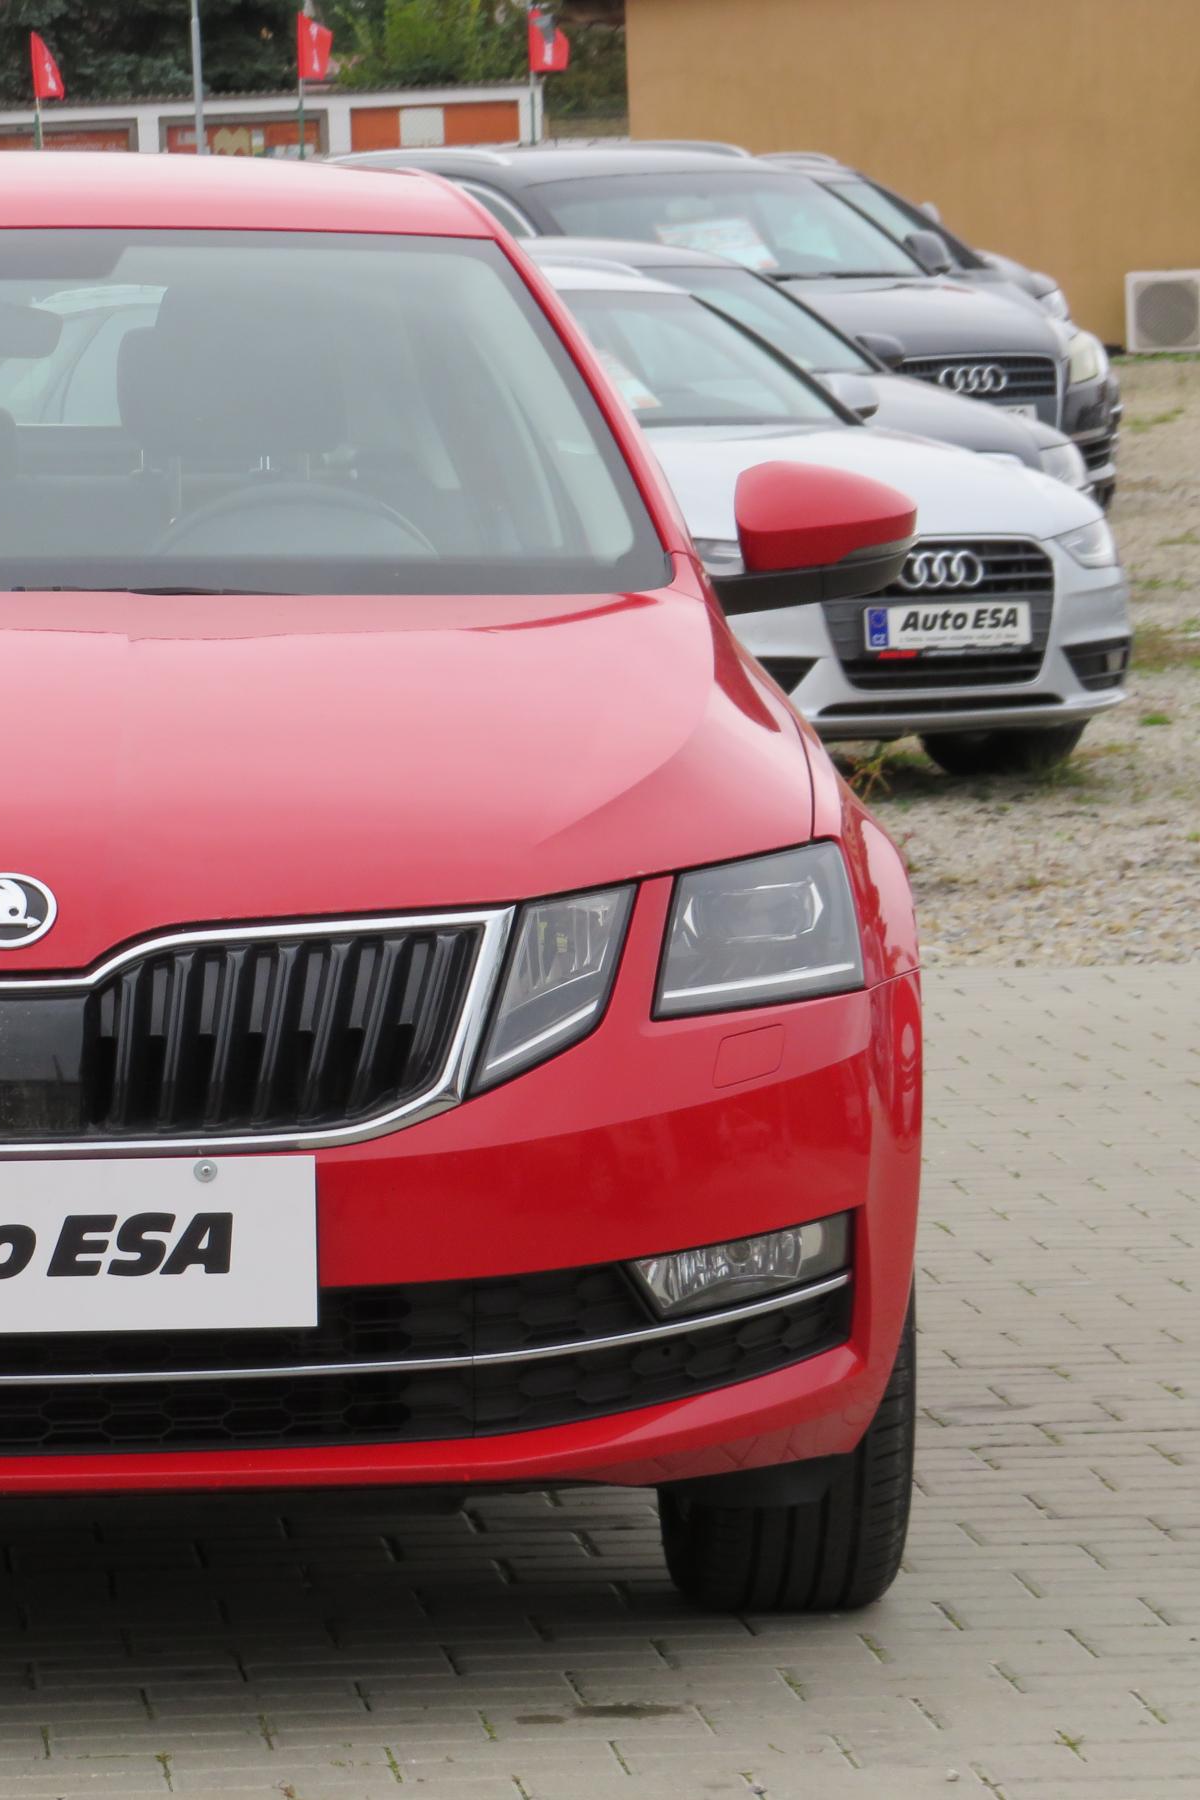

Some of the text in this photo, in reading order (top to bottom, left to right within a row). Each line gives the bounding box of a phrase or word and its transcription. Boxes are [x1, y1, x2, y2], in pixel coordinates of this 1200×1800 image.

[900, 608, 1018, 632] Auto ESA
[46, 1212, 233, 1277] ESA
